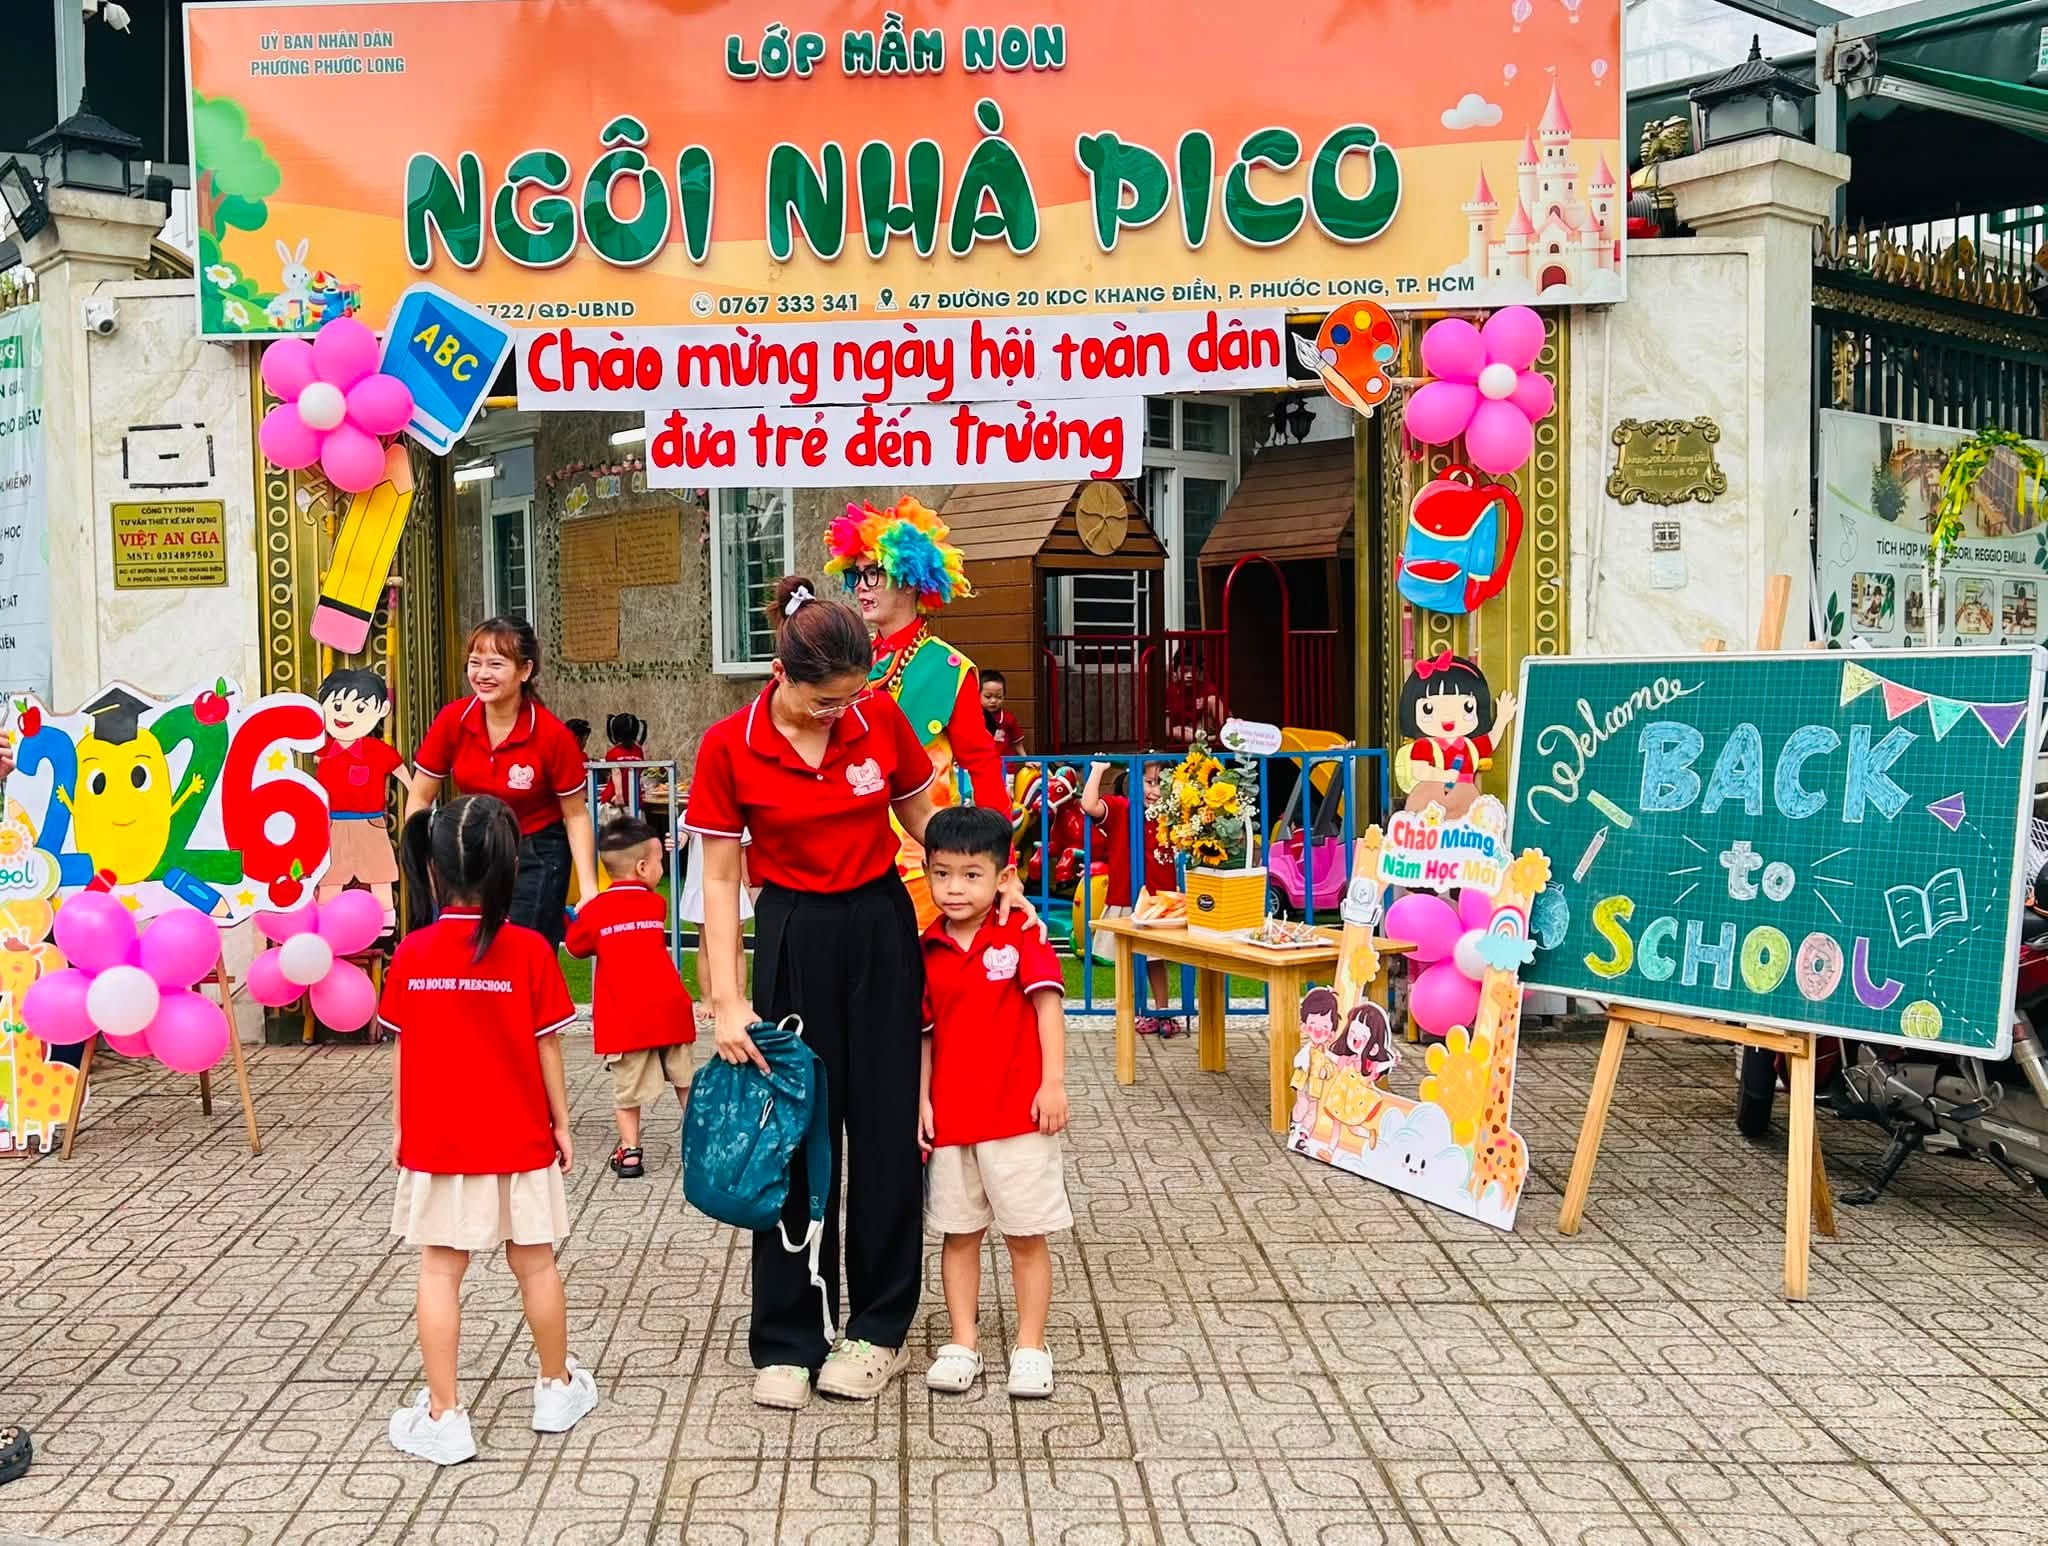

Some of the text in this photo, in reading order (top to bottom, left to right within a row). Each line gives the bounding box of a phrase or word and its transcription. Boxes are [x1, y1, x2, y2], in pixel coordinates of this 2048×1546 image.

[284, 34, 313, 49] BAN
[318, 30, 359, 48] NHÂN
[363, 29, 393, 47] DÂN
[725, 11, 1066, 79] LỚP MẦM NON
[315, 56, 362, 74] PHƯỚC
[367, 57, 405, 73] LONG
[403, 98, 1401, 270] NGÔI NHÀ PICO
[719, 294, 858, 314] 0767 333 341
[908, 275, 1474, 310] 47 ĐƯỜNG 20 KDC KHANG ĐIỀN, P. PHƯỚC LONG, TP. HCM
[476, 302, 635, 320] 722/QĐ-UBND
[413, 324, 479, 382] ABC
[527, 310, 1280, 404] Chào mừng ngày hội toàn dân
[651, 408, 736, 470] đưa
[748, 411, 828, 468] trẻ
[845, 406, 932, 468] đến
[119, 529, 220, 550] VIỆT AN GIA
[1877, 538, 1897, 555] TÍCH
[1900, 544, 1918, 560] HỢP
[1975, 548, 2001, 562] REGGIO
[2003, 550, 2027, 563] EMILIA
[1638, 720, 1919, 824] BACK
[1393, 820, 1495, 857] Chào Mừng
[1383, 853, 1499, 887] Năm Học Mới
[1719, 839, 1796, 902] to
[1583, 895, 1904, 1011] SCHOOL
[407, 978, 513, 993] PICO HOUSE PRESCHOOL
